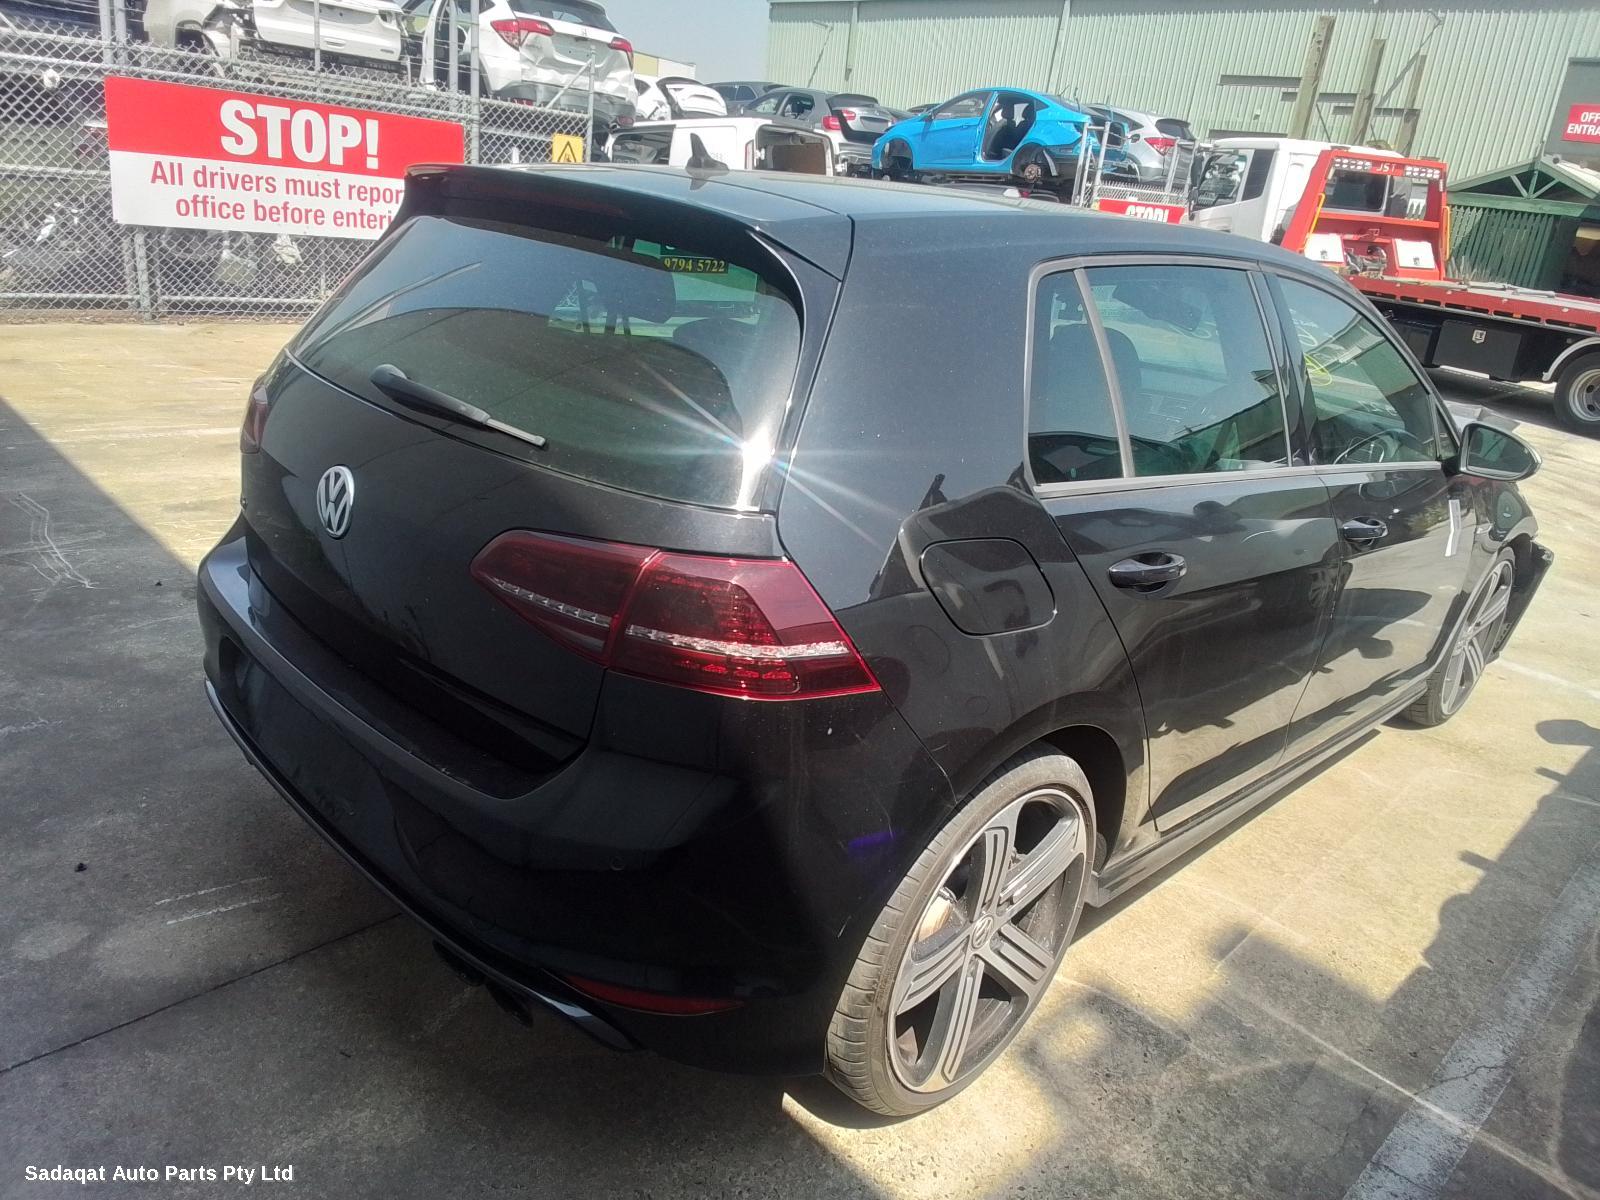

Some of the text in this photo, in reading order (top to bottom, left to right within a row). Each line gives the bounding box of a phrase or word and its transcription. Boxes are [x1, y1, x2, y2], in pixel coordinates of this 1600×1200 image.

[219, 99, 379, 170] STOP!
[150, 160, 184, 187] All
[193, 165, 277, 194] drivers
[285, 175, 341, 201] must
[175, 194, 245, 221] office
[253, 199, 325, 227] before
[663, 257, 725, 273] 9794 5722
